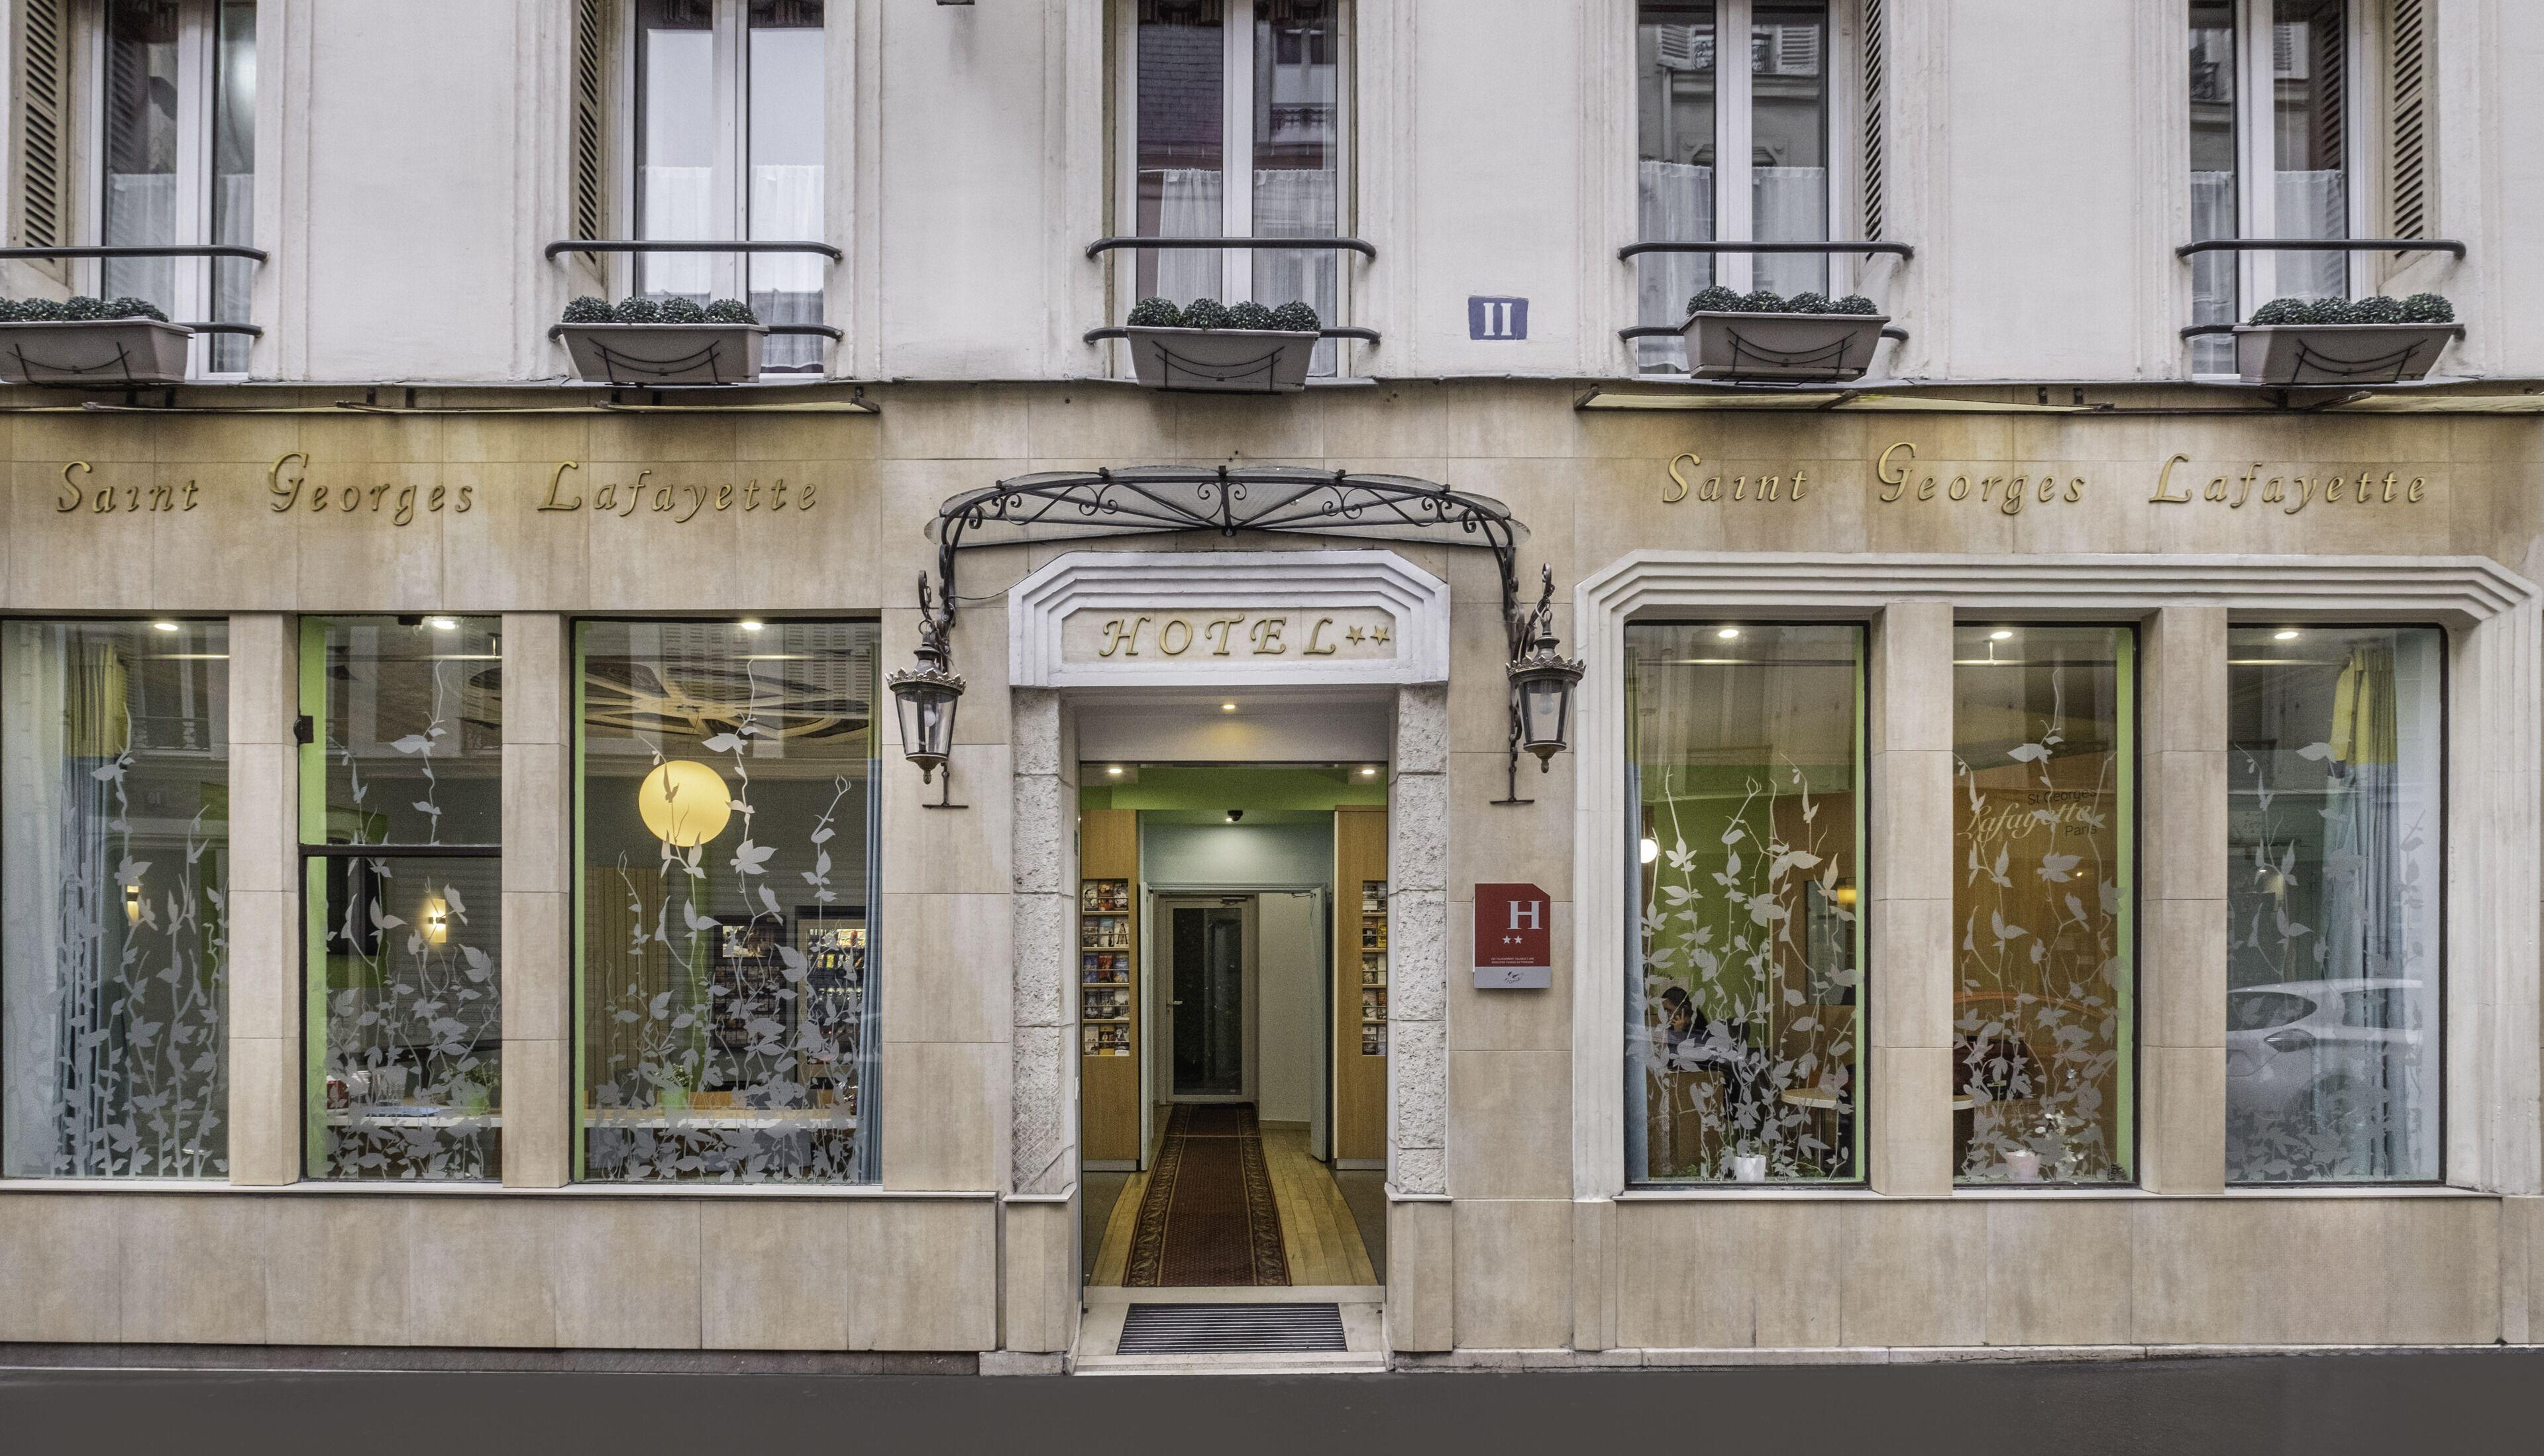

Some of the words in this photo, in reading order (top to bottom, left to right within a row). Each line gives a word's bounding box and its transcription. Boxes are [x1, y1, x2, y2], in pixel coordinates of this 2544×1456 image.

[57, 460, 199, 513] Saint
[267, 452, 473, 526] Georges
[537, 460, 816, 523] Lafayette
[1662, 452, 1807, 503] Saint
[1877, 442, 2086, 515] Georges
[2148, 452, 2427, 515] Lafayette
[1098, 613, 1336, 657] HOTEL
[2027, 794, 2040, 806] St
[2044, 788, 2097, 803] Georges
[1507, 900, 1543, 930] H
